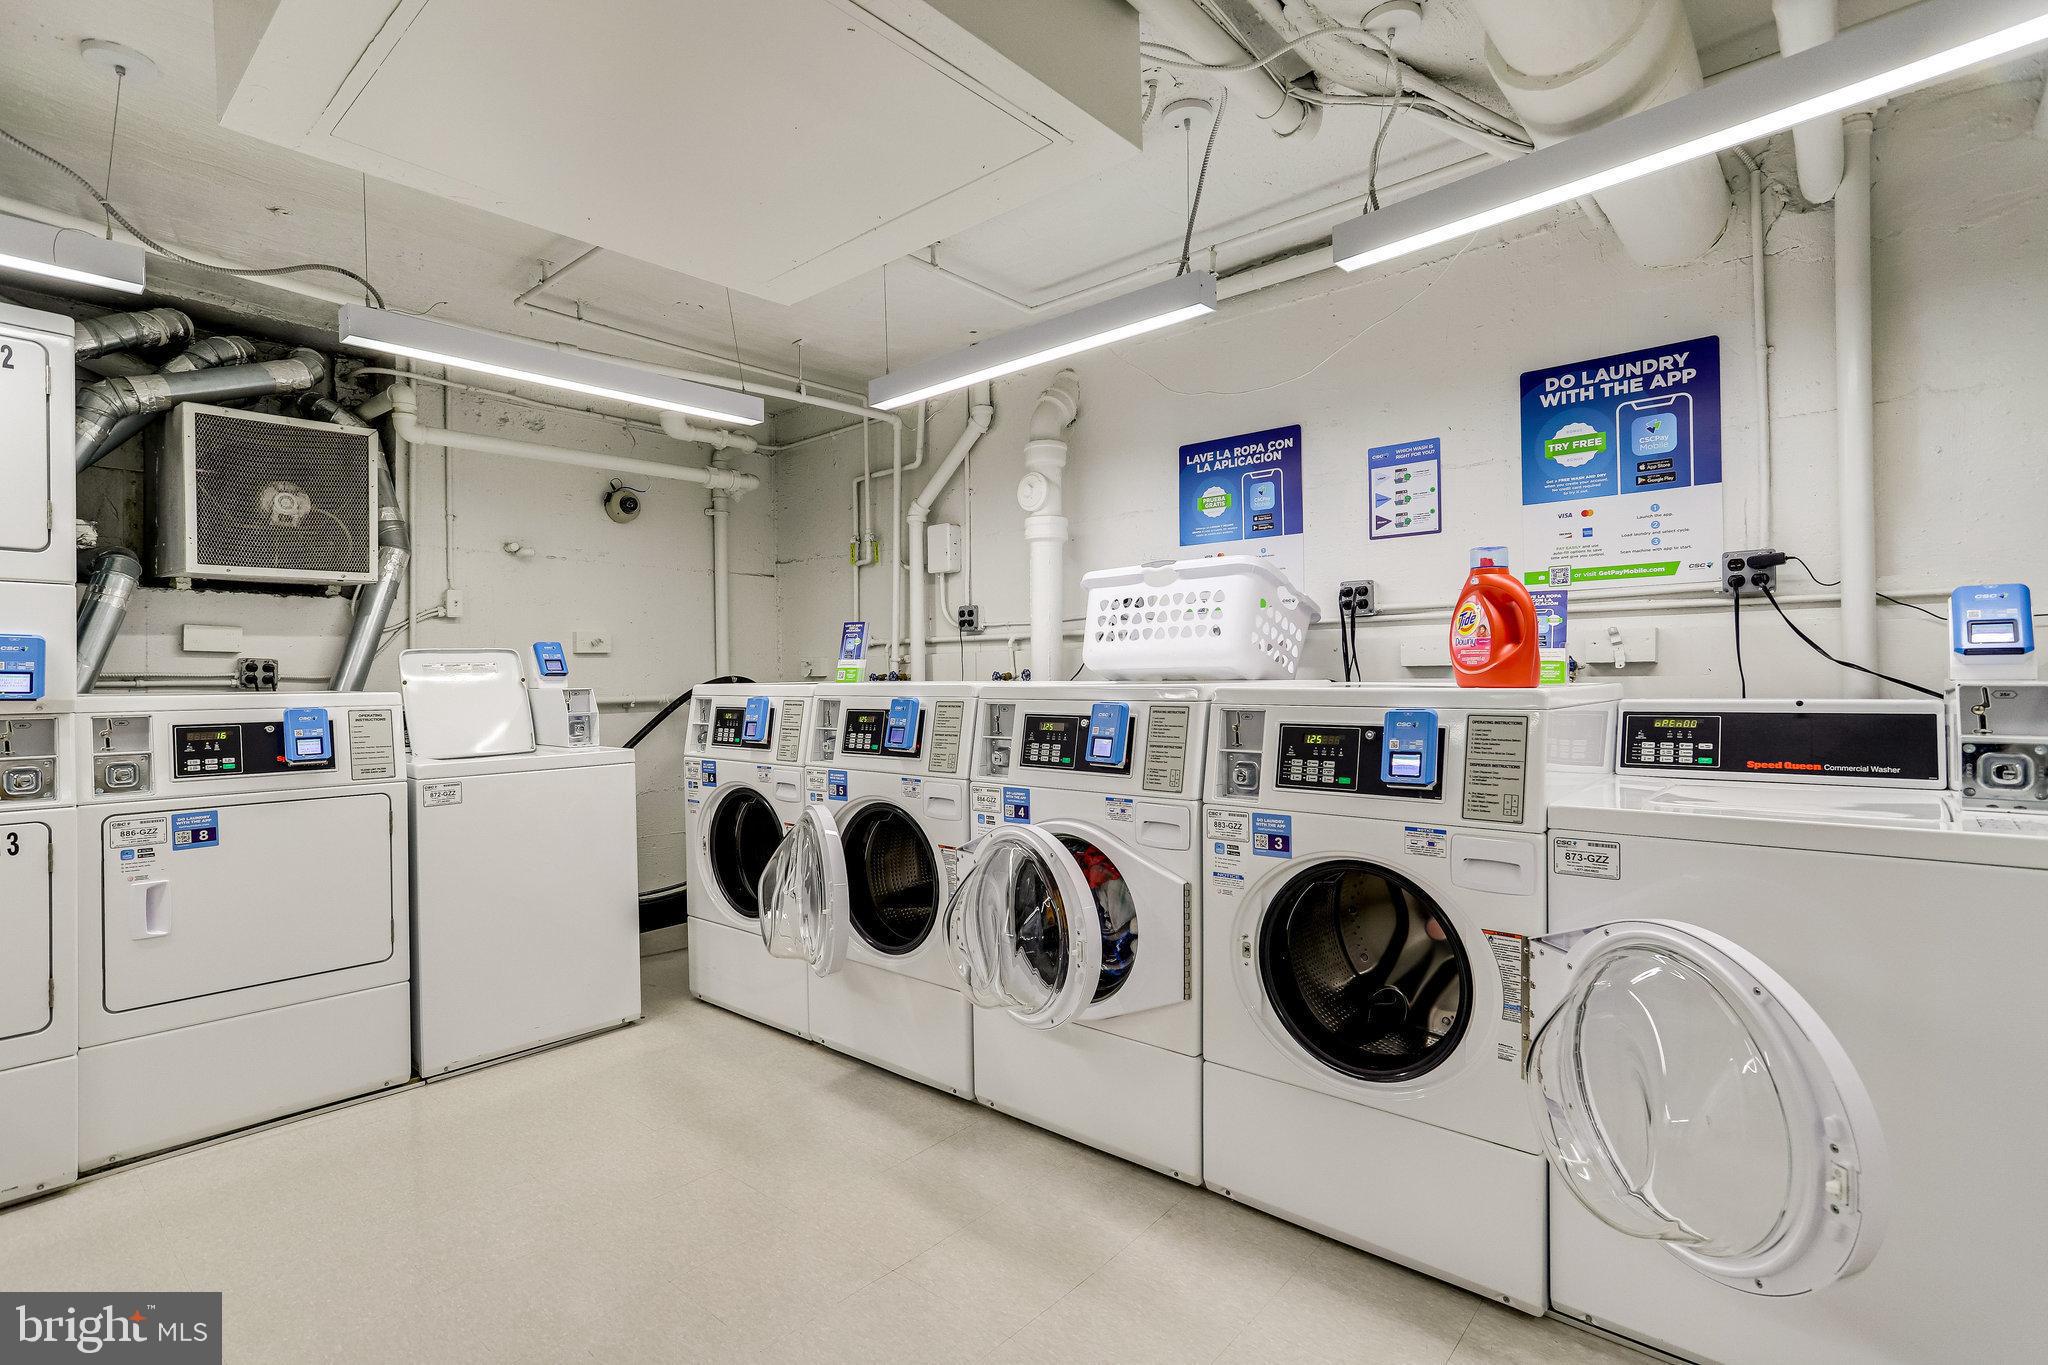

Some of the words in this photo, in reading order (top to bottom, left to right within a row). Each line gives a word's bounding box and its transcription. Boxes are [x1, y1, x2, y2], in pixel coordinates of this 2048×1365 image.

[1, 344, 14, 369] 2
[1545, 374, 1576, 392] DO
[1581, 351, 1690, 386] LAUNDRY
[1539, 387, 1594, 408] WITH
[1600, 377, 1644, 398] THE
[1649, 368, 1697, 390] APP
[1548, 442, 1569, 452] TRY
[1572, 437, 1603, 449] FREE
[1639, 434, 1669, 444] CSCPay
[1186, 452, 1214, 465] LAVE
[1216, 449, 1231, 460] LA
[1234, 443, 1265, 456] ROPA
[1268, 438, 1294, 450] CON
[1197, 463, 1211, 473] LA
[1214, 450, 1282, 471] APLICACIÓN
[1202, 496, 1226, 504] PRUEBA
[1598, 567, 1665, 578] GetPayMobile.com
[1458, 611, 1476, 630] Tide
[1455, 638, 1476, 647] Downy
[1747, 761, 1783, 770] Speed
[1784, 761, 1823, 771] Queen
[1824, 764, 1869, 773] Commercial
[1870, 765, 1900, 774] Washer
[839, 787, 844, 795] 5
[1018, 807, 1025, 817] 4
[1214, 821, 1243, 830] 883-GZZ
[120, 828, 158, 837] 886-GZZ
[199, 830, 208, 841] 8
[7, 832, 19, 856] 3
[1274, 837, 1283, 849] 3
[1565, 852, 1609, 864] 873-GZZ
